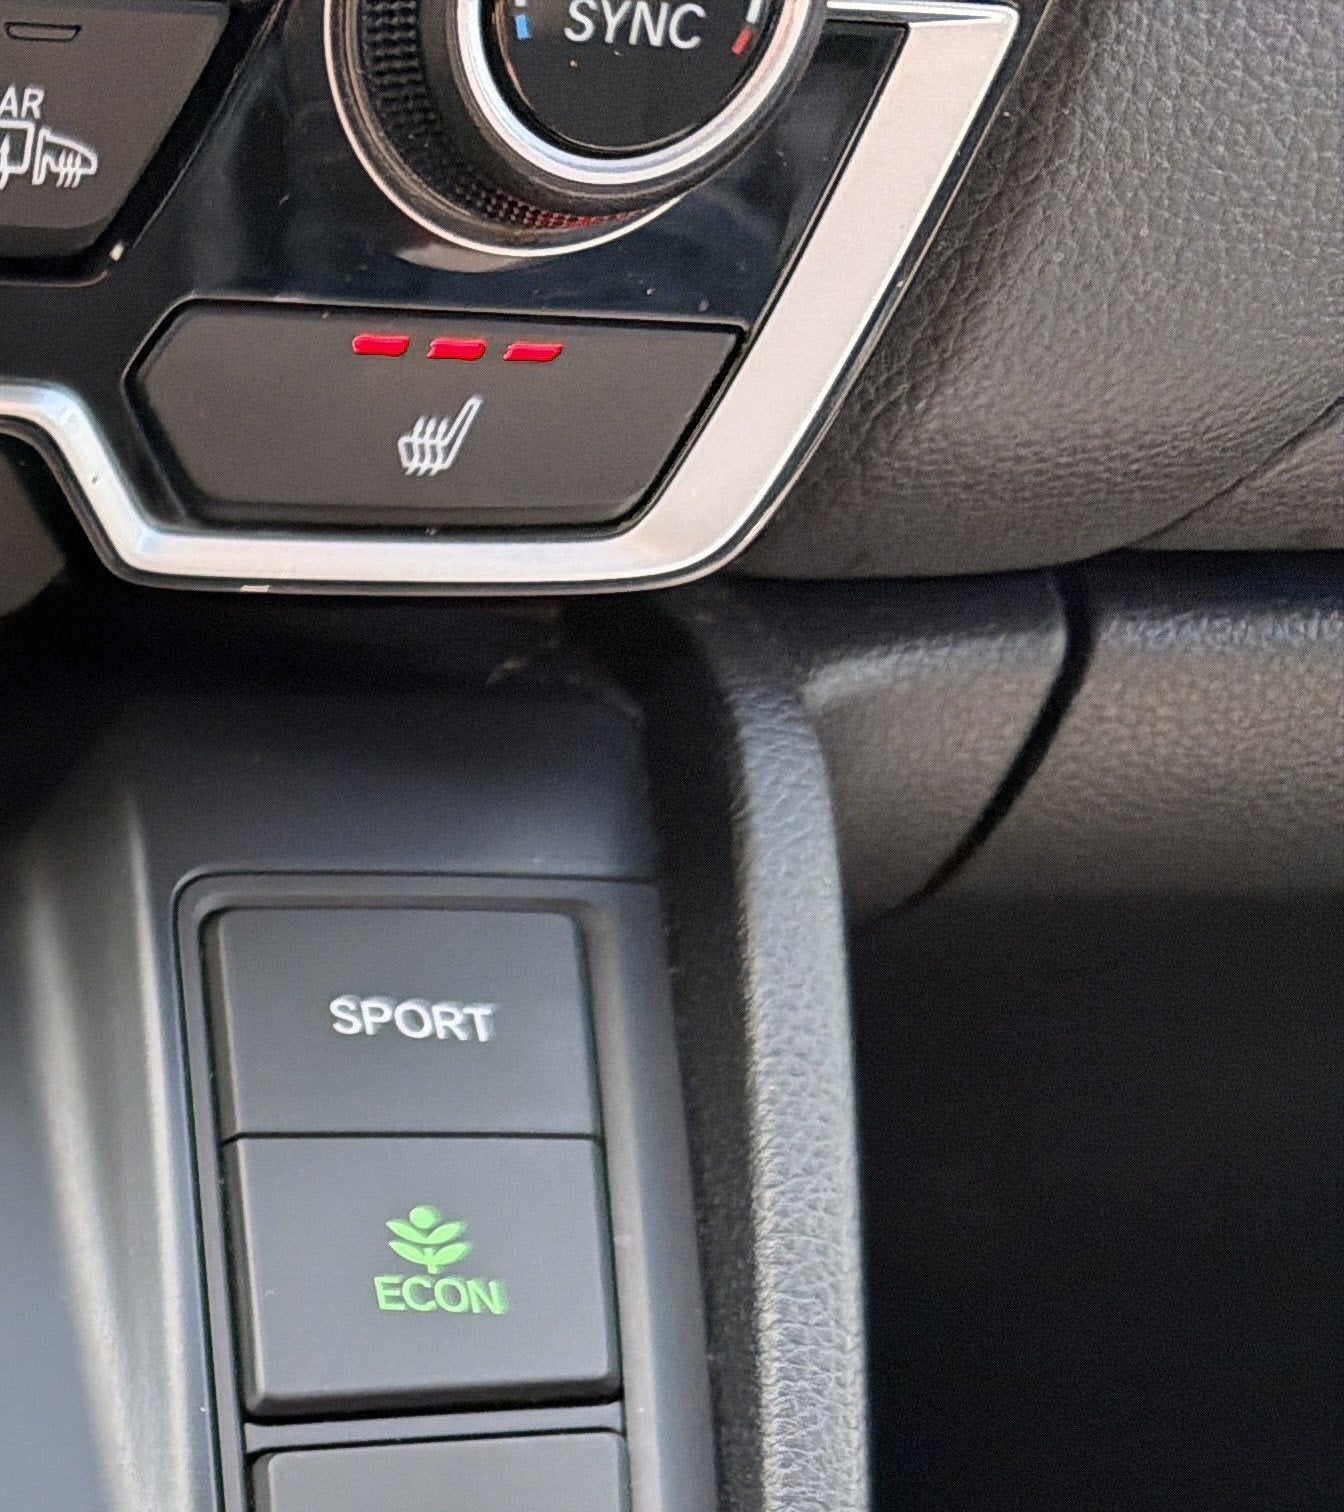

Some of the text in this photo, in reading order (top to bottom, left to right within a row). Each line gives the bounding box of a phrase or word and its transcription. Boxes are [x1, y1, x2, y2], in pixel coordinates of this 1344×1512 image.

[564, 0, 705, 49] SYNC
[328, 993, 496, 1043] SPORT
[374, 1275, 506, 1316] ECON
